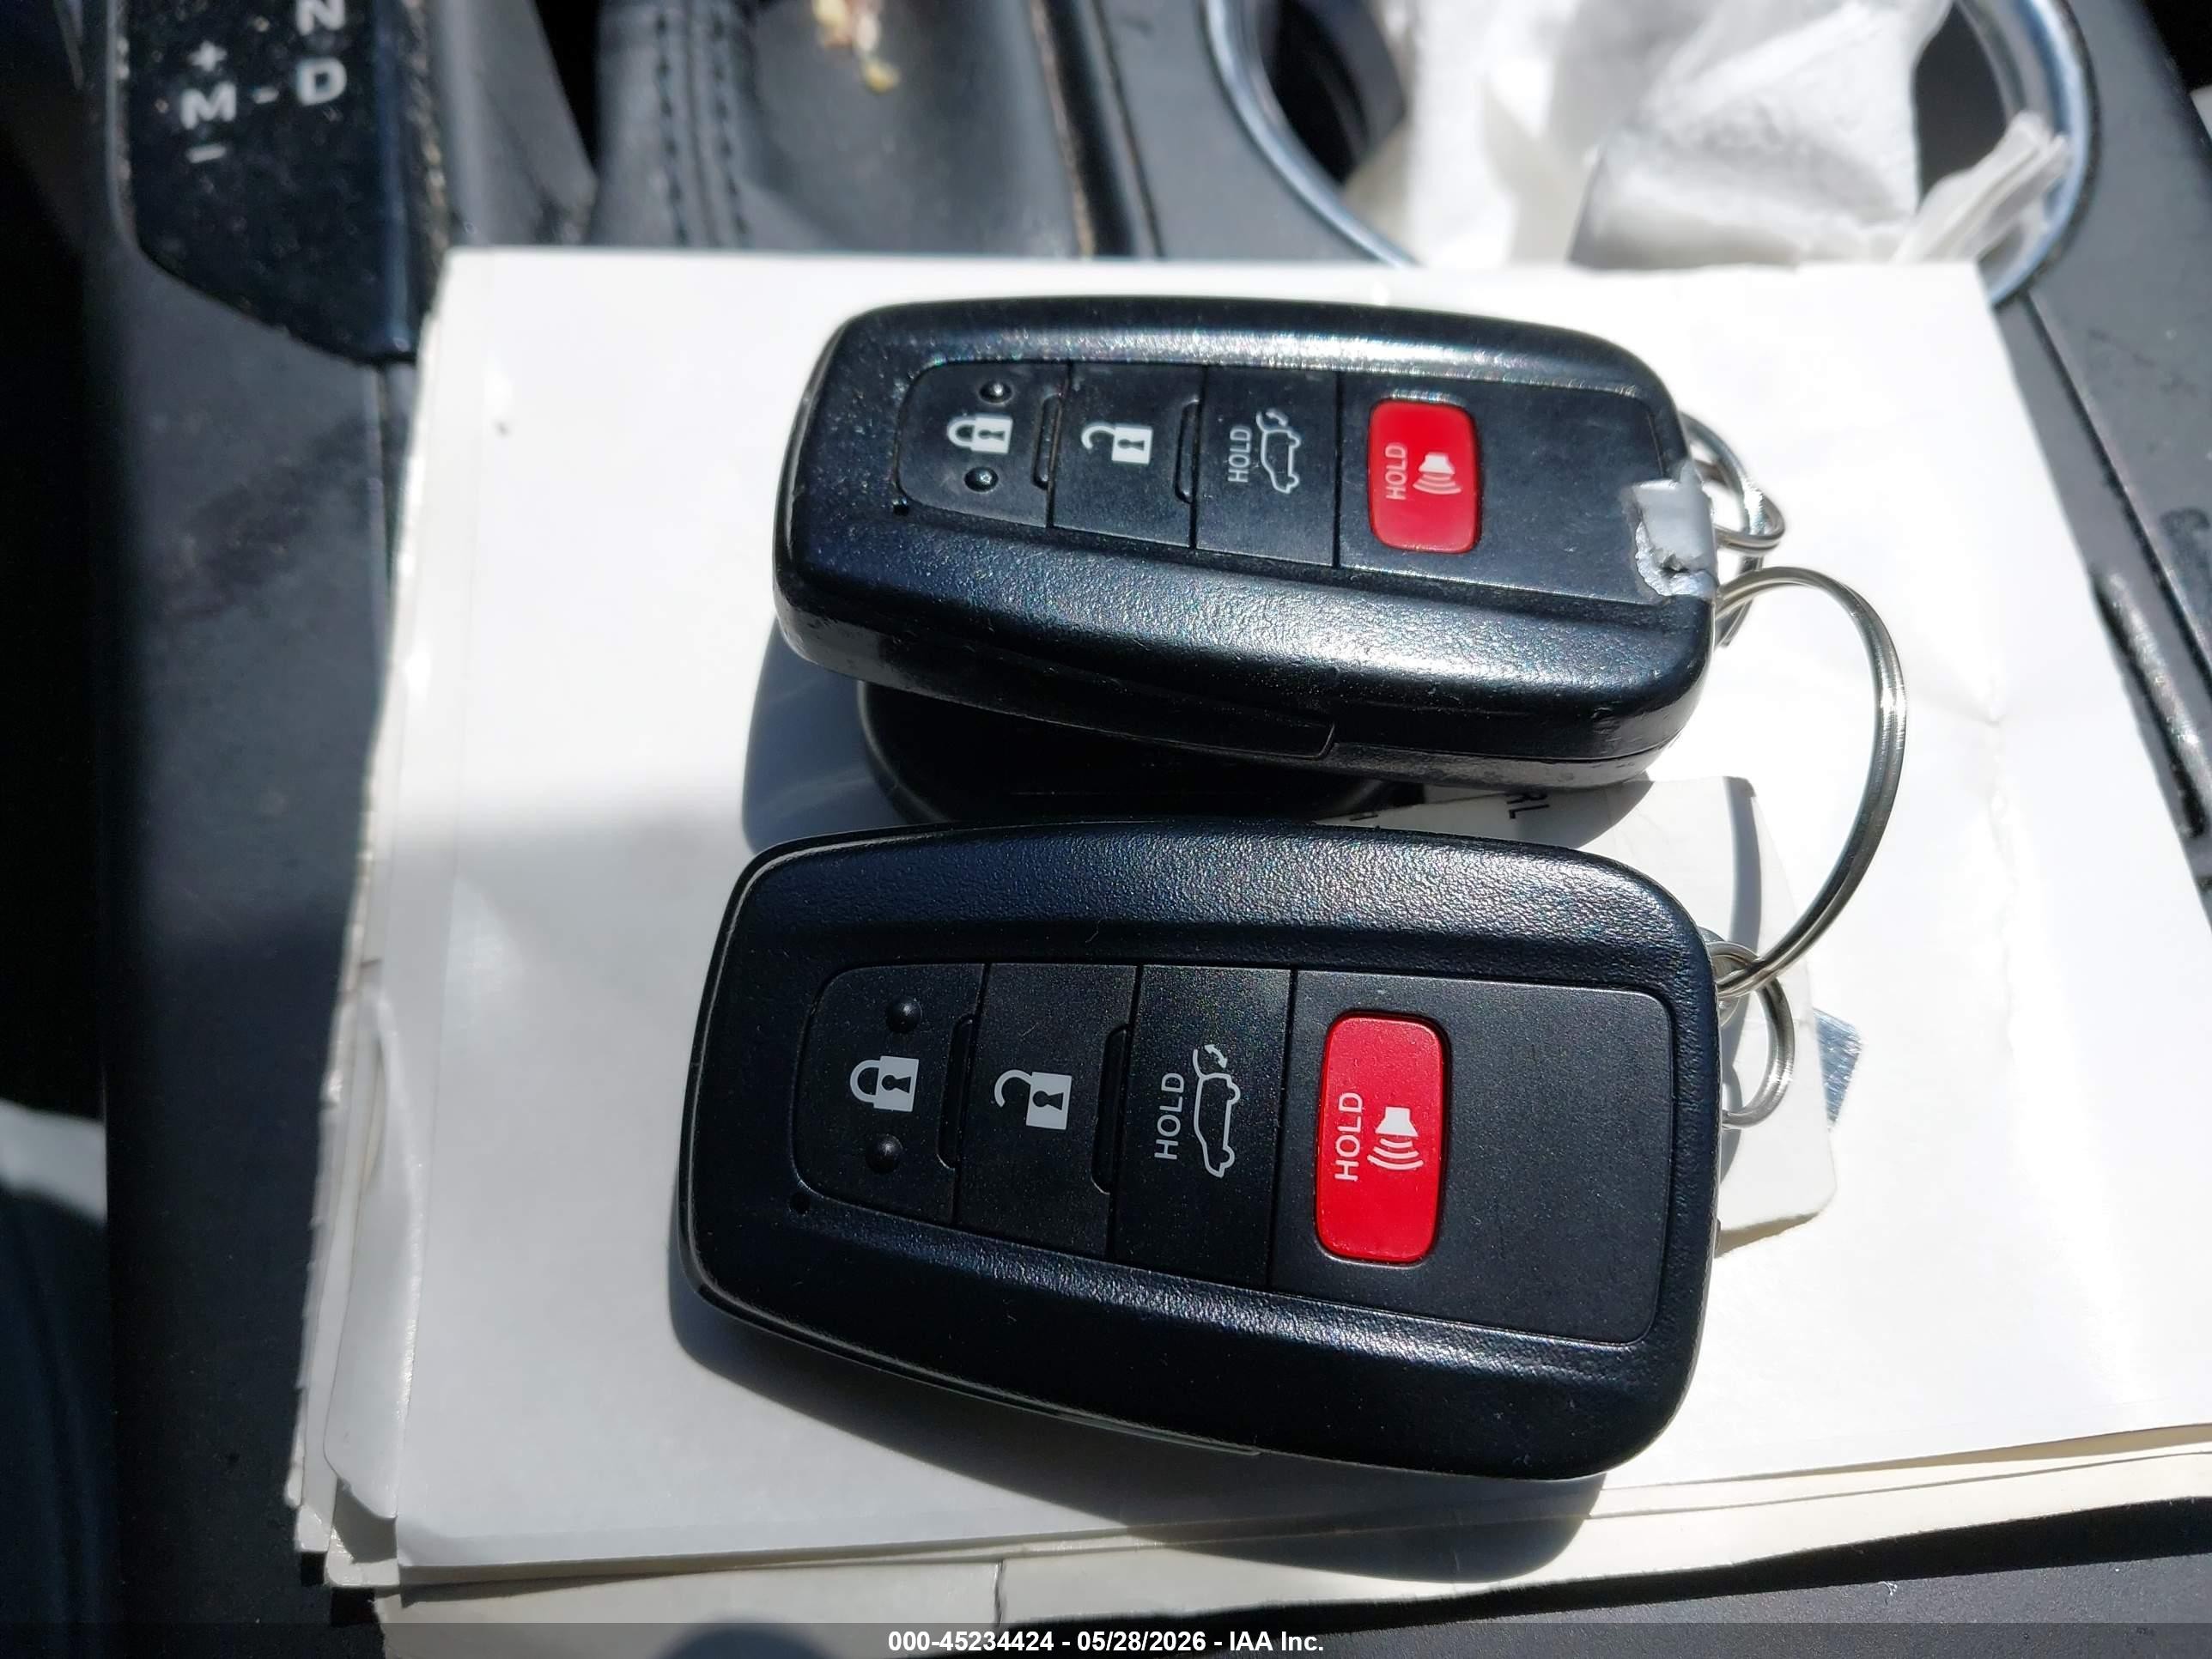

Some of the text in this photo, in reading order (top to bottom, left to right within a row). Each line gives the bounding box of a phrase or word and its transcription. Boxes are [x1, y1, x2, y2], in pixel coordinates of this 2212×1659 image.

[295, 0, 345, 34] N
[181, 82, 237, 130] M
[295, 57, 347, 106] D
[1228, 428, 1252, 483] HOLD
[1385, 442, 1408, 501] HOLD
[1155, 1073, 1184, 1160] HOLD
[1334, 1092, 1363, 1182] HOLD
